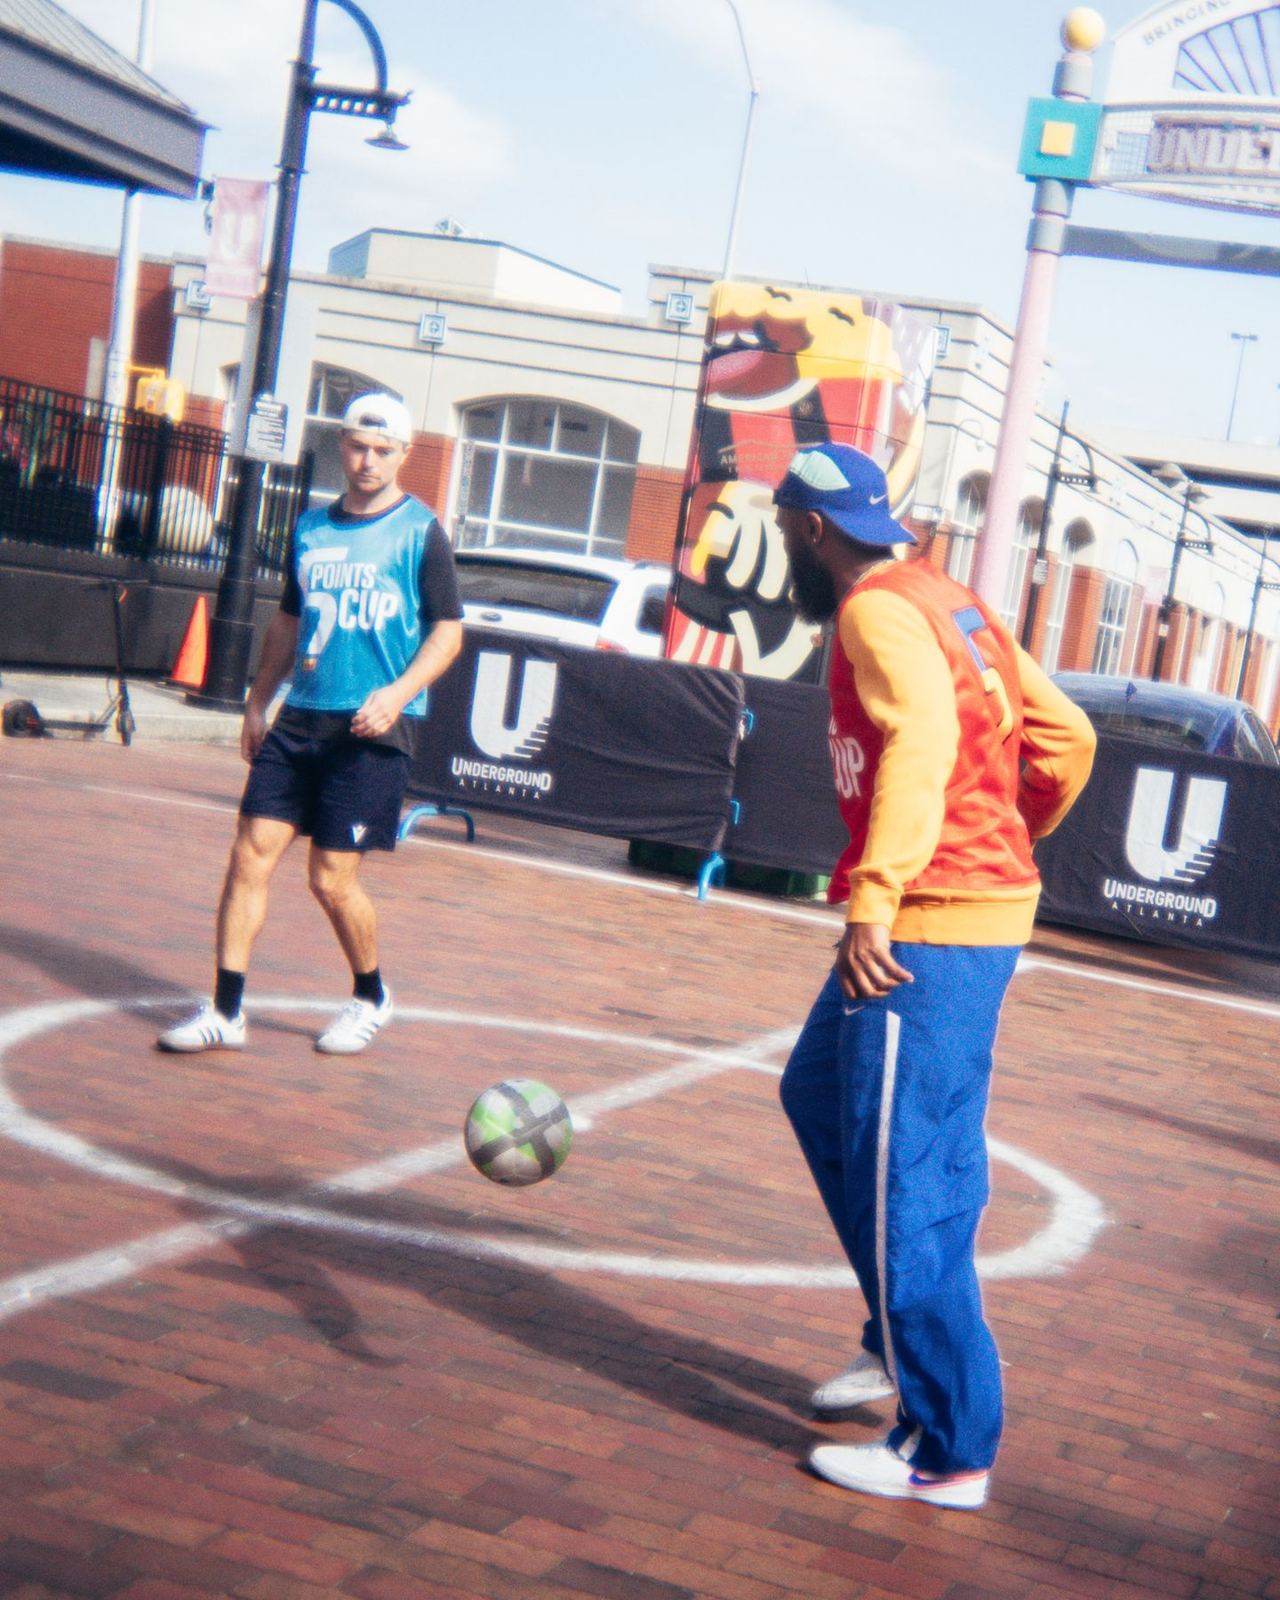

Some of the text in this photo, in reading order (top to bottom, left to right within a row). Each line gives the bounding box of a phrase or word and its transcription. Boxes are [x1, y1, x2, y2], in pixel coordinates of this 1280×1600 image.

[310, 562, 377, 590] POINTS
[338, 588, 400, 632] CUP
[470, 652, 557, 759] U
[451, 756, 552, 792] UNDERGROUND
[828, 736, 865, 799] UP
[458, 778, 541, 800] ATLANTA
[1125, 767, 1228, 884] U
[1103, 878, 1217, 919] UNDERGROUND
[1111, 901, 1203, 928] ATLANTA
